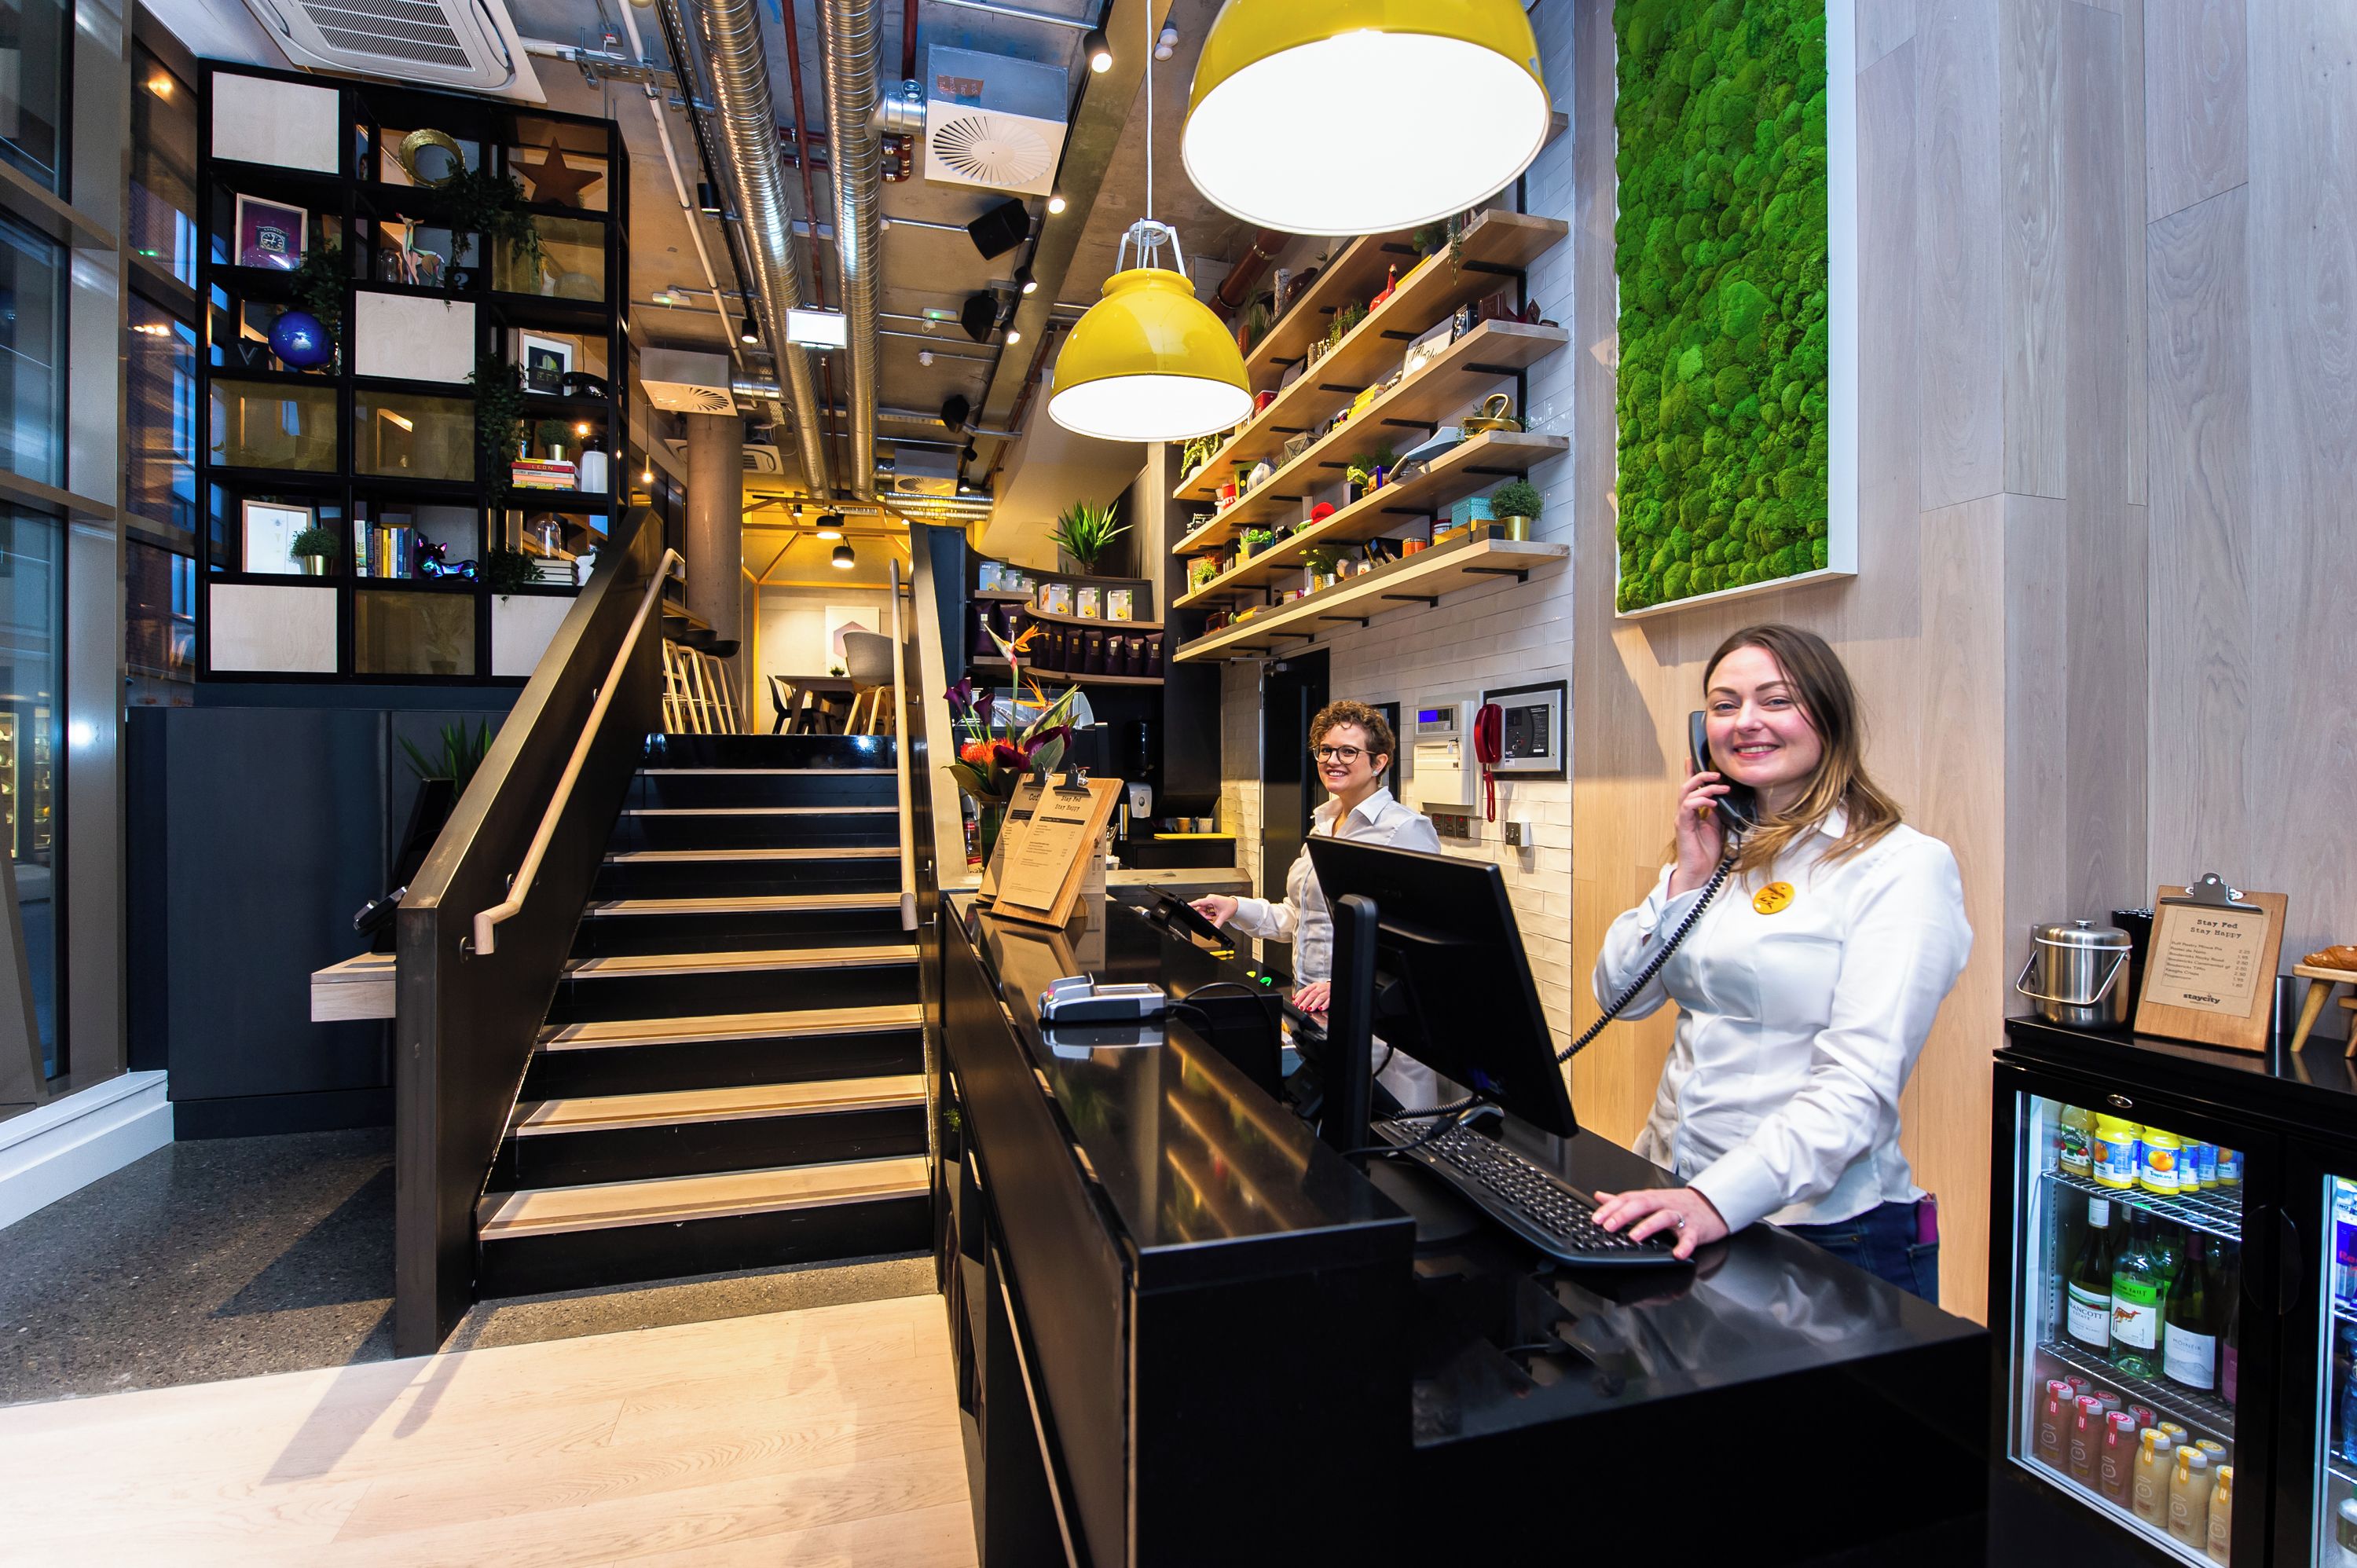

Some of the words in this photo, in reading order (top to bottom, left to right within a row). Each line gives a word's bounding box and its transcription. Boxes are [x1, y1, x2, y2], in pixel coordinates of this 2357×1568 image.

[2197, 919, 2218, 928] Stay
[2190, 927, 2210, 936] Stay
[2215, 930, 2242, 939] Happy
[2183, 994, 2220, 1004] staycity
[2150, 1171, 2172, 1179] Tropicana
